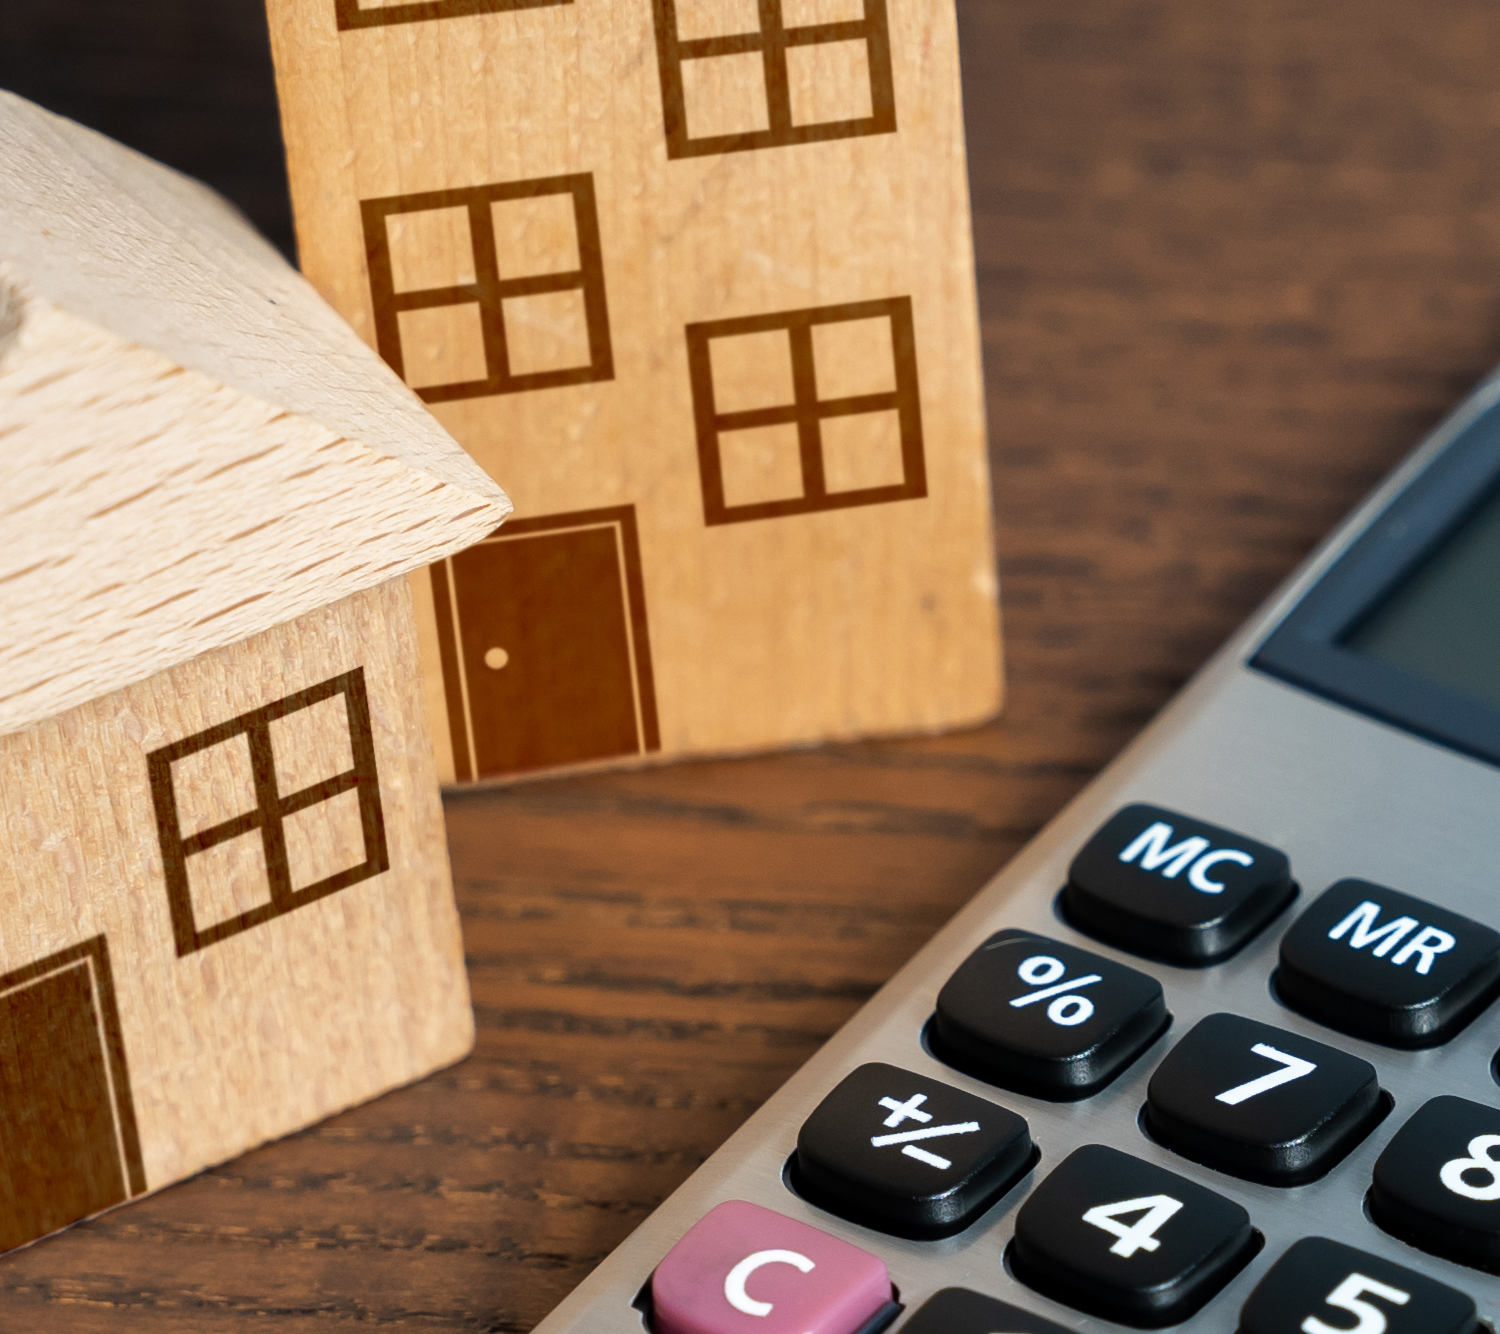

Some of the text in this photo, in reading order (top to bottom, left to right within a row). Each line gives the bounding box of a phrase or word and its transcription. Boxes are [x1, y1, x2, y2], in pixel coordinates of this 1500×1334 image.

[1119, 822, 1254, 894] MC
[1327, 900, 1457, 976] MR
[1213, 1041, 1318, 1107] 7
[1080, 1193, 1185, 1259] 4
[723, 1248, 817, 1318] C
